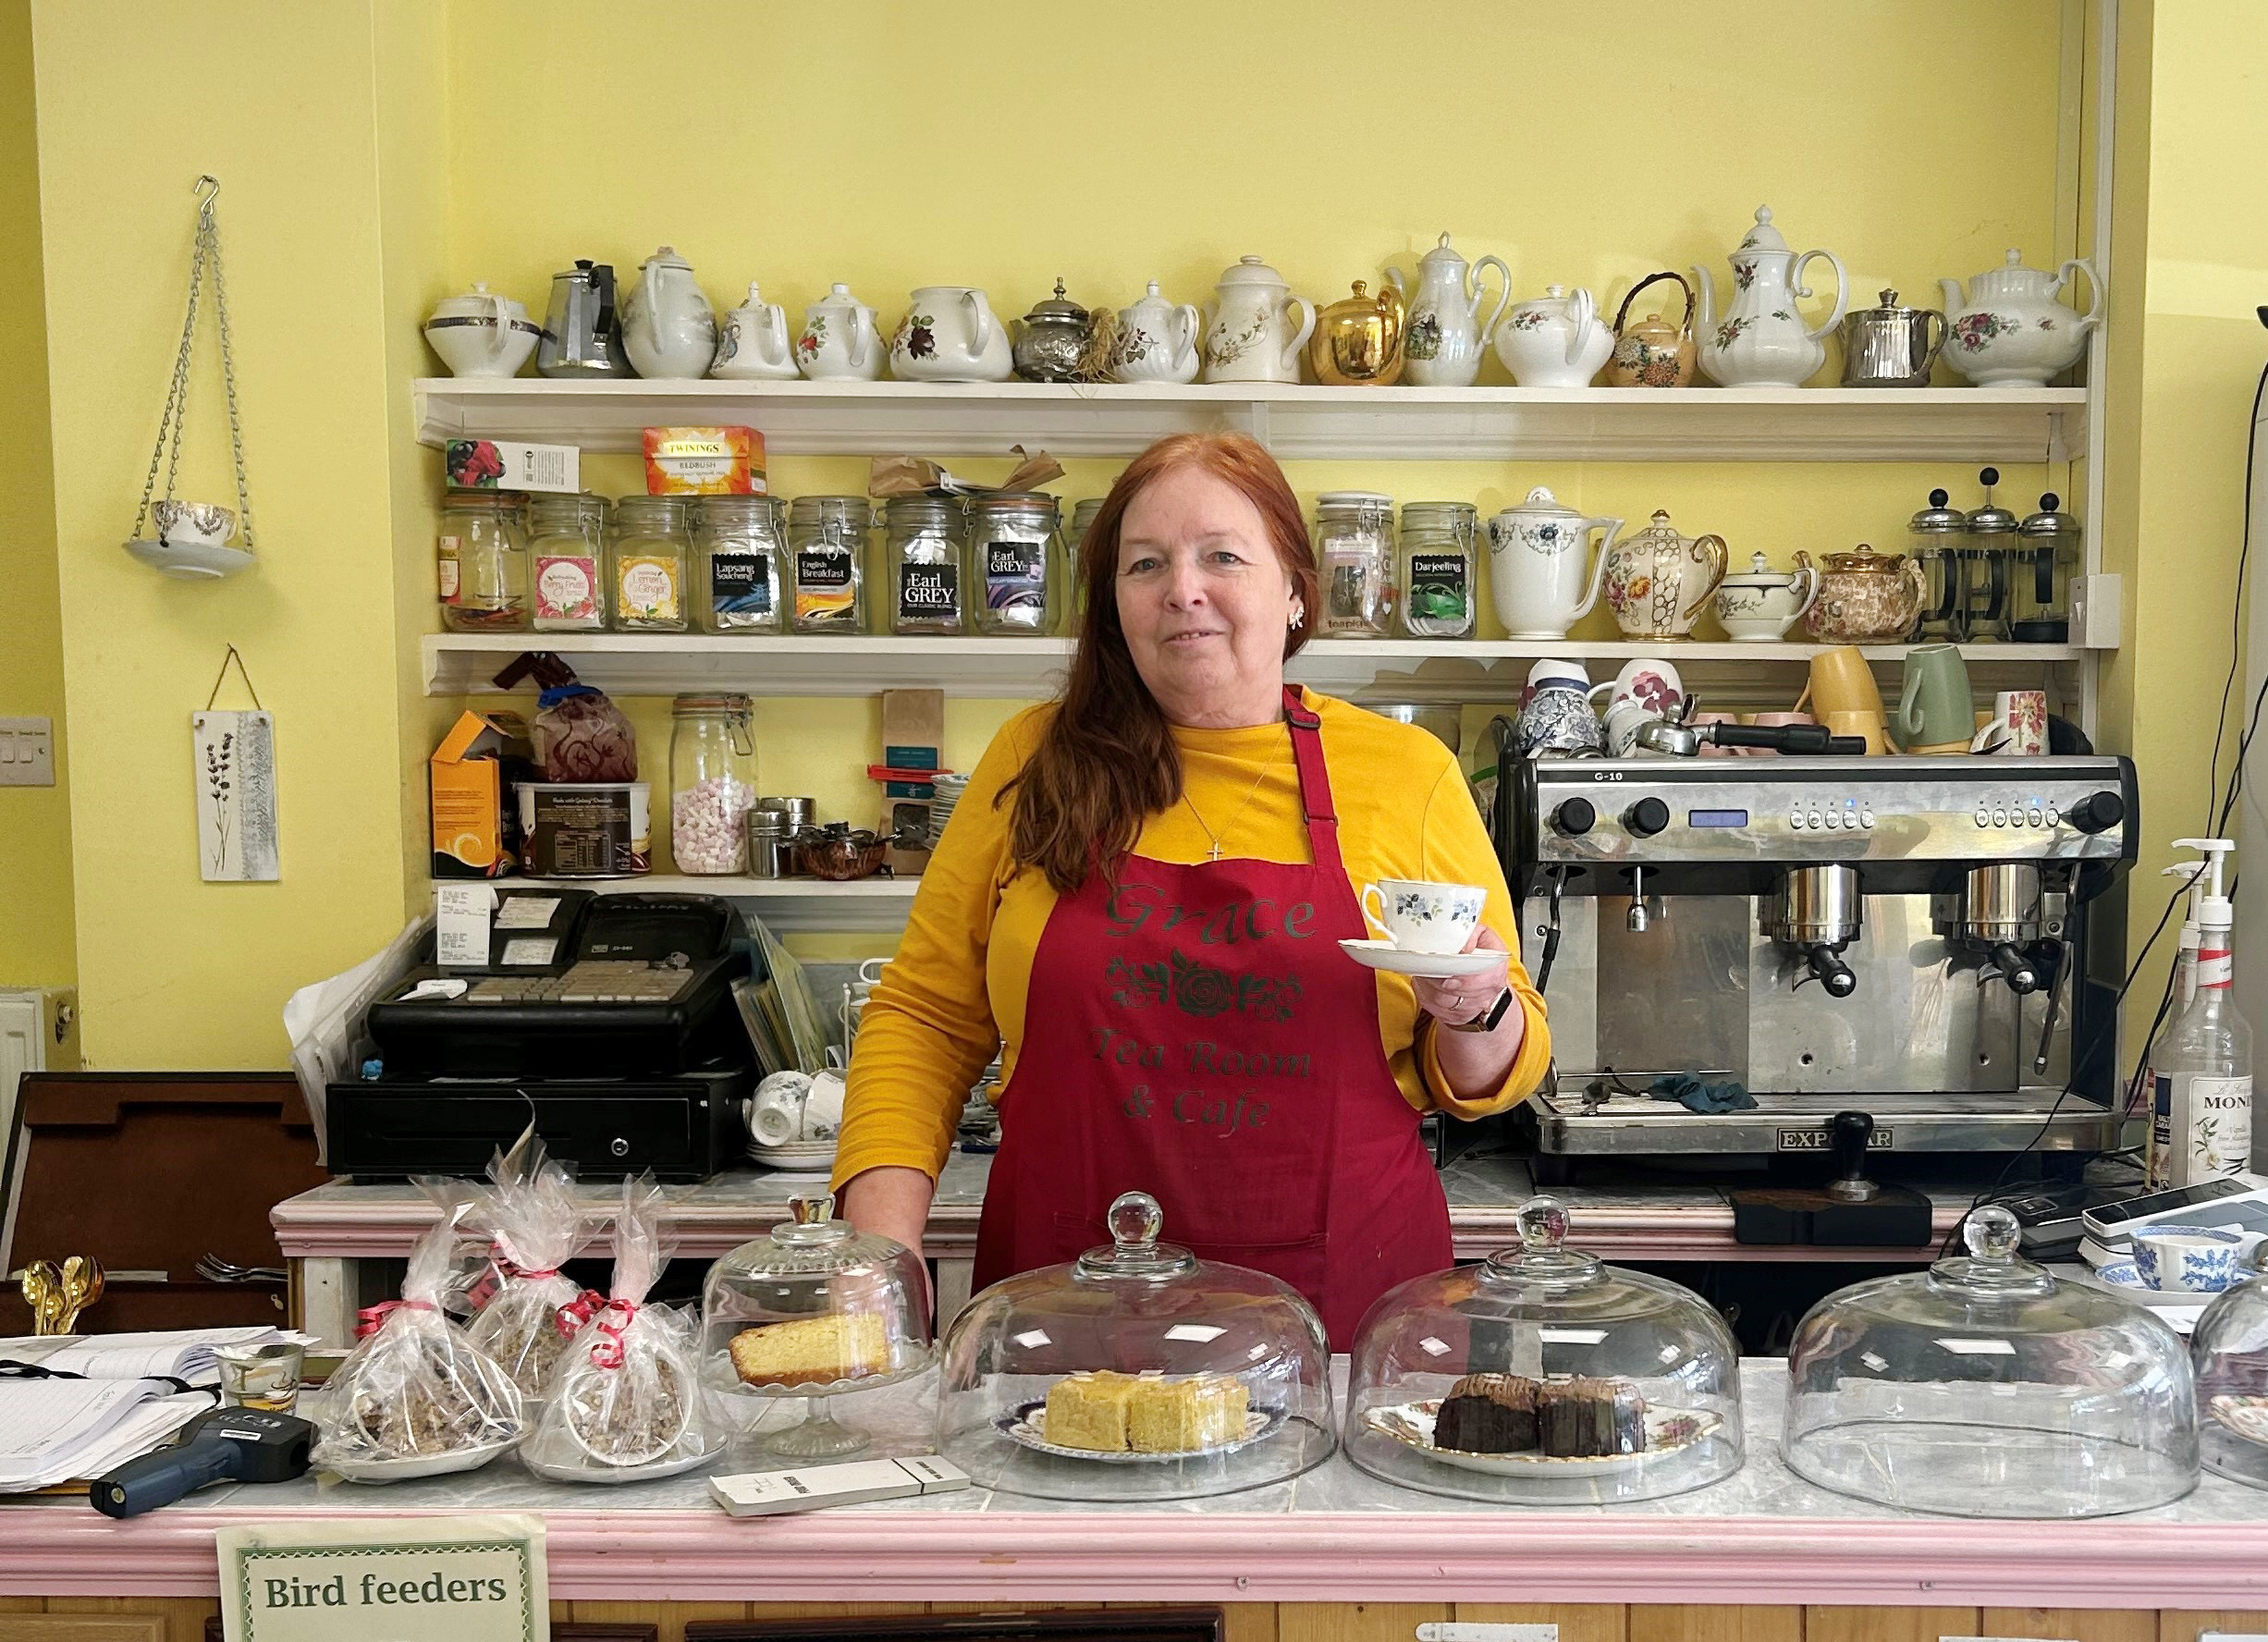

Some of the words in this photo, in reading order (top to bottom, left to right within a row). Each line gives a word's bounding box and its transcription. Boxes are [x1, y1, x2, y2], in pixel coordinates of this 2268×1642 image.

[668, 444, 719, 454] TWININGS
[679, 461, 717, 470] REDBUSH
[992, 549, 1015, 561] Earl
[716, 563, 755, 574] Lapsang
[802, 560, 828, 570] English
[990, 559, 1024, 572] GREY
[1415, 561, 1462, 573] Darjeeling
[632, 573, 668, 585] Lemon
[716, 572, 754, 582] Souchong
[802, 569, 845, 578] Breakfast
[910, 572, 942, 588] Earl
[639, 582, 667, 600] Ginger
[904, 586, 955, 604] GREY
[1594, 772, 1624, 781] G-10
[1105, 881, 1318, 945] Grace
[1091, 1027, 1166, 1069] Tea
[1184, 1041, 1311, 1078] Room
[1123, 1084, 1155, 1119] &
[1172, 1087, 1271, 1139] Cafe
[1782, 1132, 1892, 1147] EXPR
[264, 1575, 348, 1608] Bird
[360, 1572, 508, 1606] feeders
